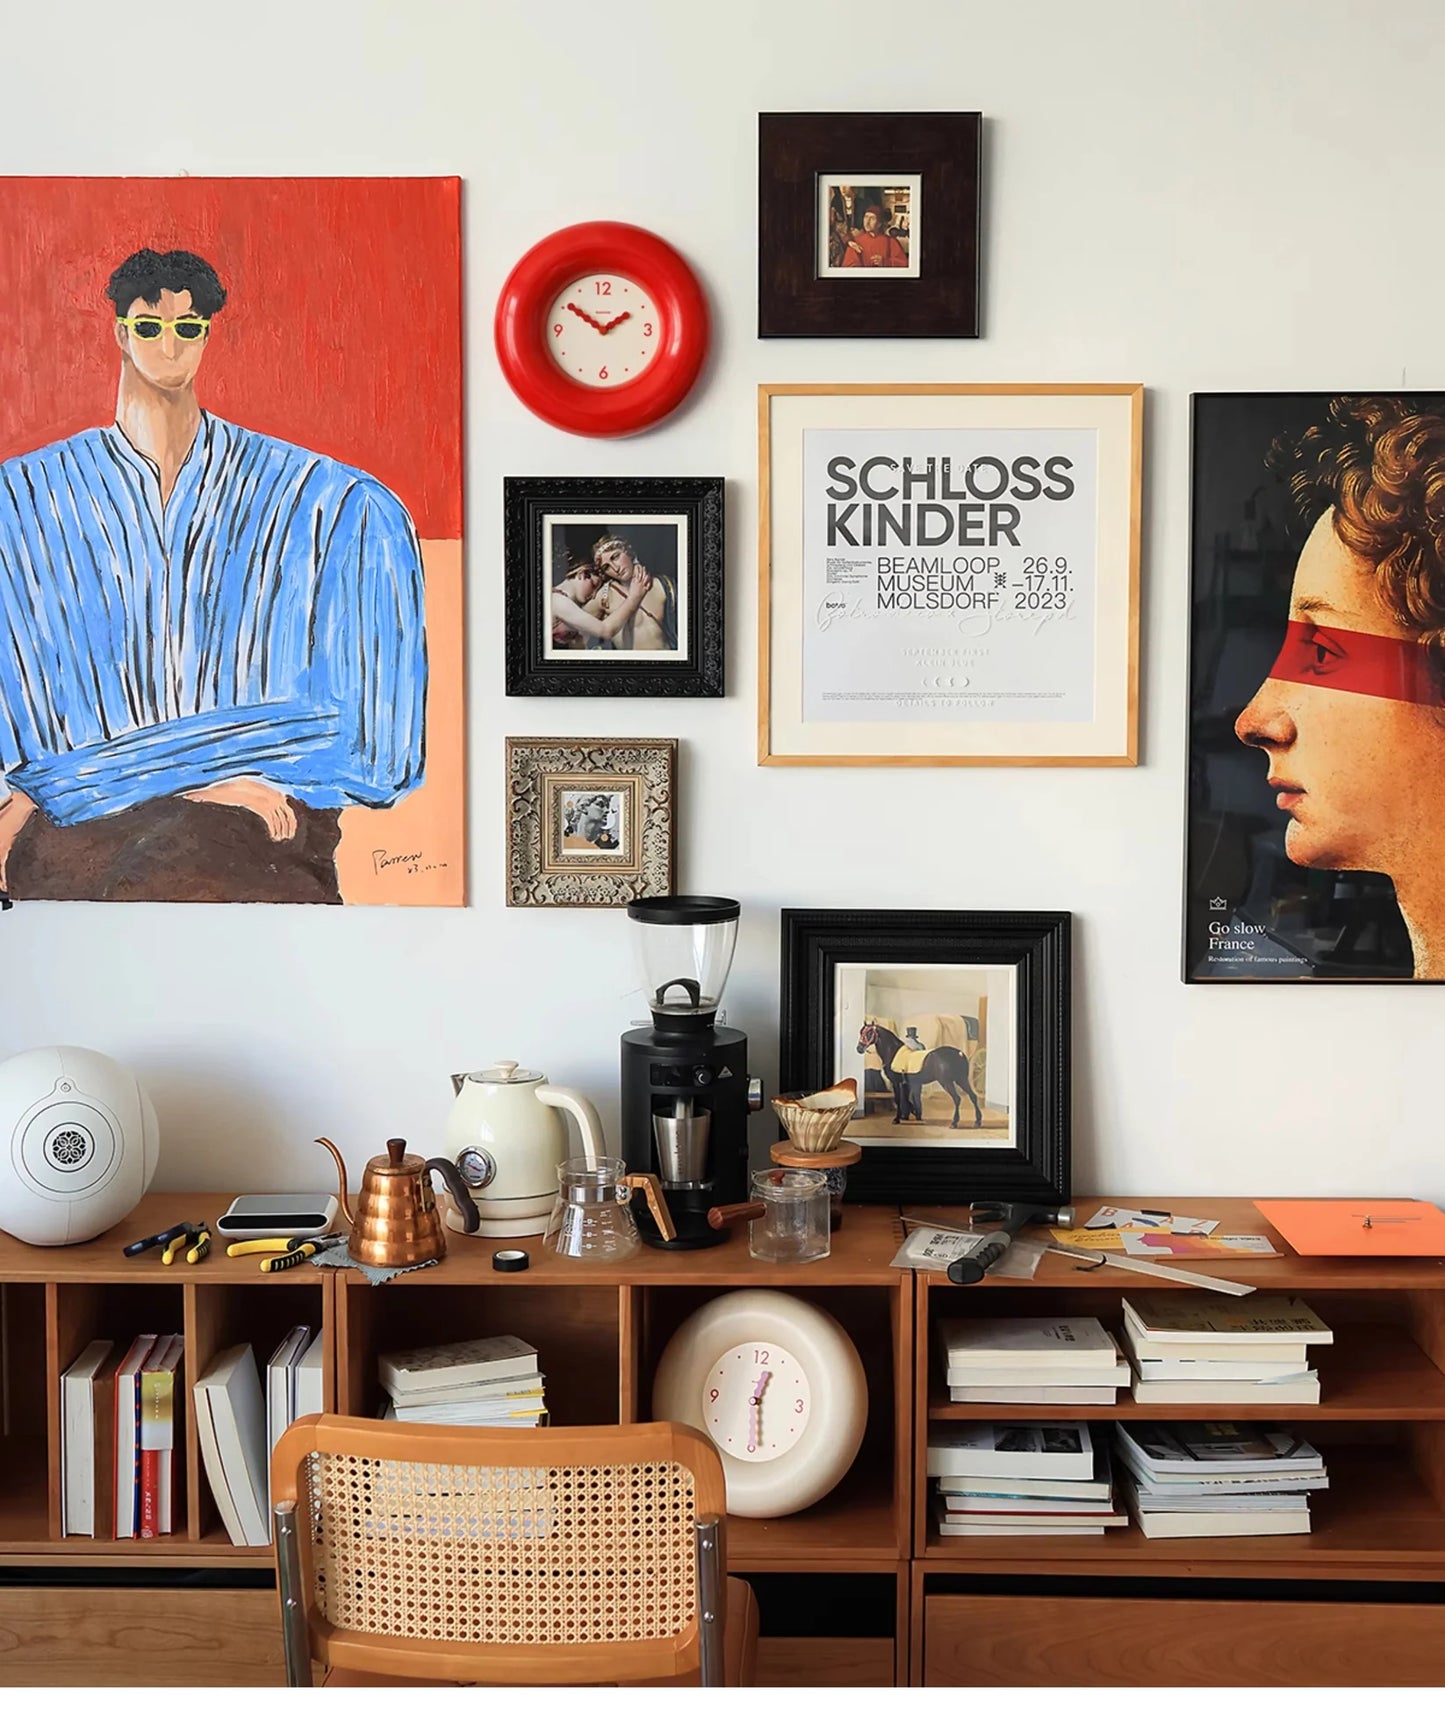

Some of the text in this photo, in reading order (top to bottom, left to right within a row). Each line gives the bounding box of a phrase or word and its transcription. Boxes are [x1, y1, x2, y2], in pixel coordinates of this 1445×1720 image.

[595, 281, 611, 295] 12
[553, 323, 652, 337] 9 3
[599, 365, 608, 379] 6
[825, 456, 1075, 501] SCHLOSS
[827, 503, 1021, 546] KINDER
[877, 557, 1000, 574] BEAMLOOP
[1023, 557, 1073, 574] 26.9.
[877, 575, 974, 591] MUSEUM
[877, 593, 1067, 609] MOLSDORF 2023
[1208, 921, 1266, 935] Go slow
[1208, 937, 1255, 950] France
[754, 1350, 769, 1365] 12
[710, 1388, 804, 1414] 9 3
